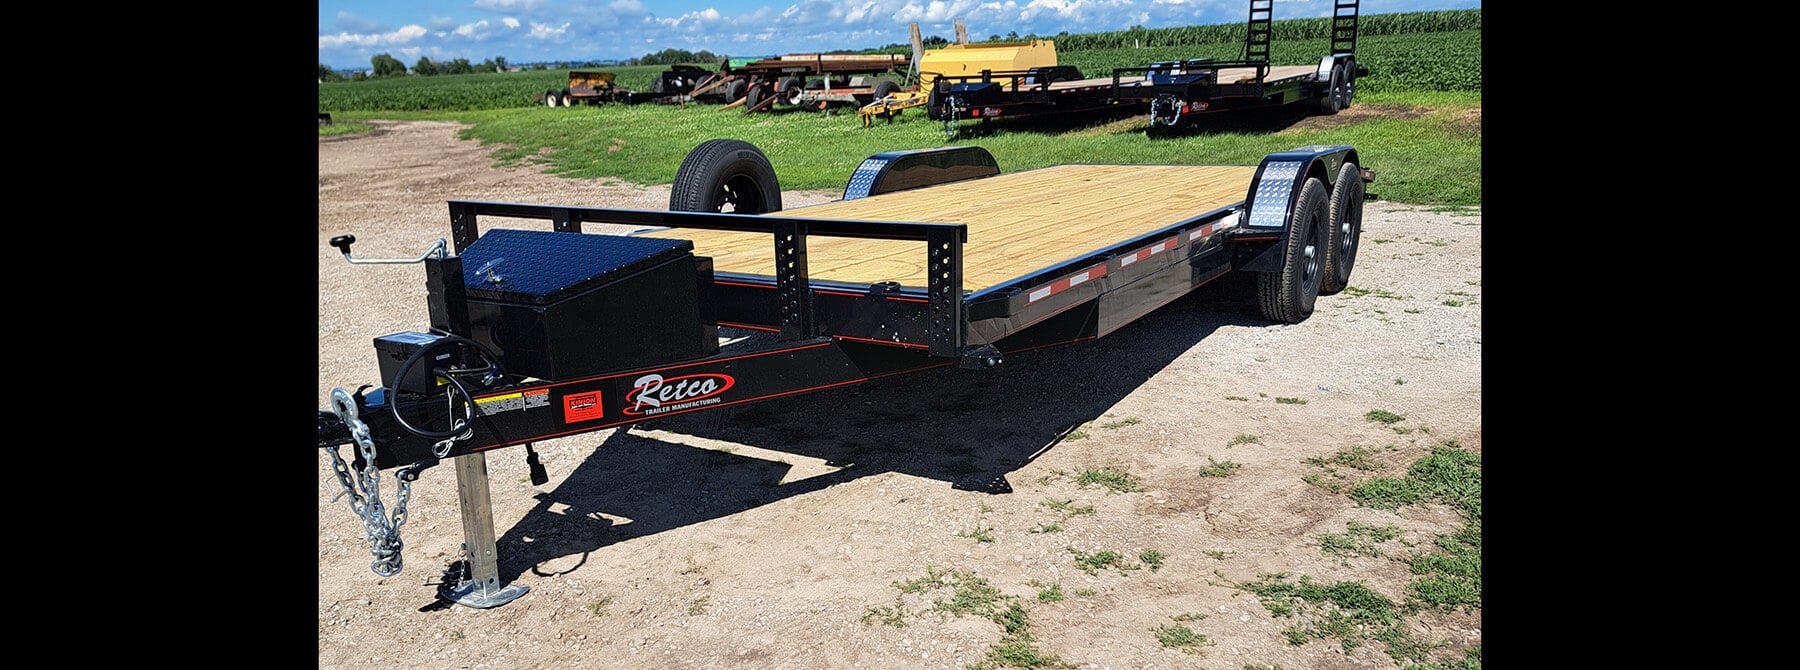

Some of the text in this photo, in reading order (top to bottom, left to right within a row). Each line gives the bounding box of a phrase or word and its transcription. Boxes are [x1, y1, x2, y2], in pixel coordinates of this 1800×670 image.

[634, 374, 718, 411] Retco
[644, 397, 721, 416] TRAILER MANUFACTURING
